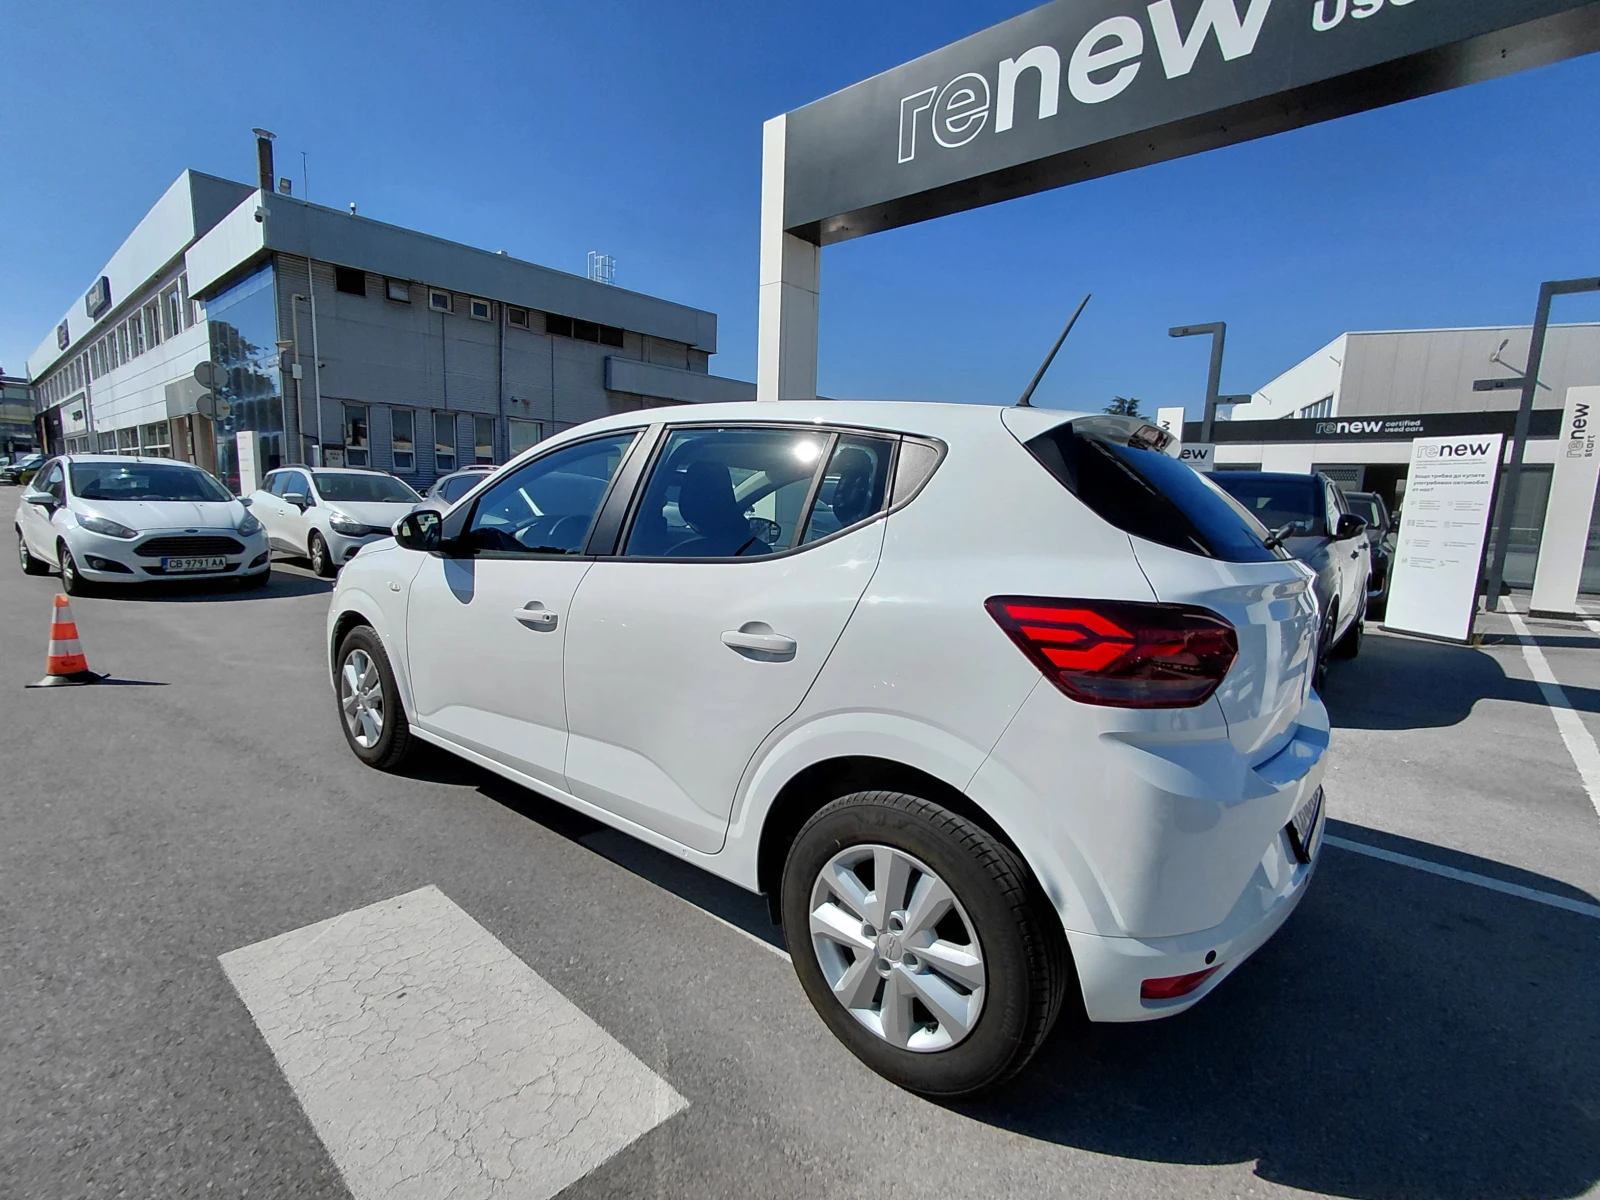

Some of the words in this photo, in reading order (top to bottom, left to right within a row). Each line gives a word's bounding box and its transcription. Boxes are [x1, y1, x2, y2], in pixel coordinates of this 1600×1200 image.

[898, 0, 1271, 164] renew
[1315, 421, 1383, 434] renew
[1566, 403, 1590, 458] renew
[1416, 442, 1491, 458] renew
[1584, 434, 1596, 458] start
[169, 560, 183, 568] CB
[185, 559, 209, 568] 9791
[212, 558, 224, 567] AA
